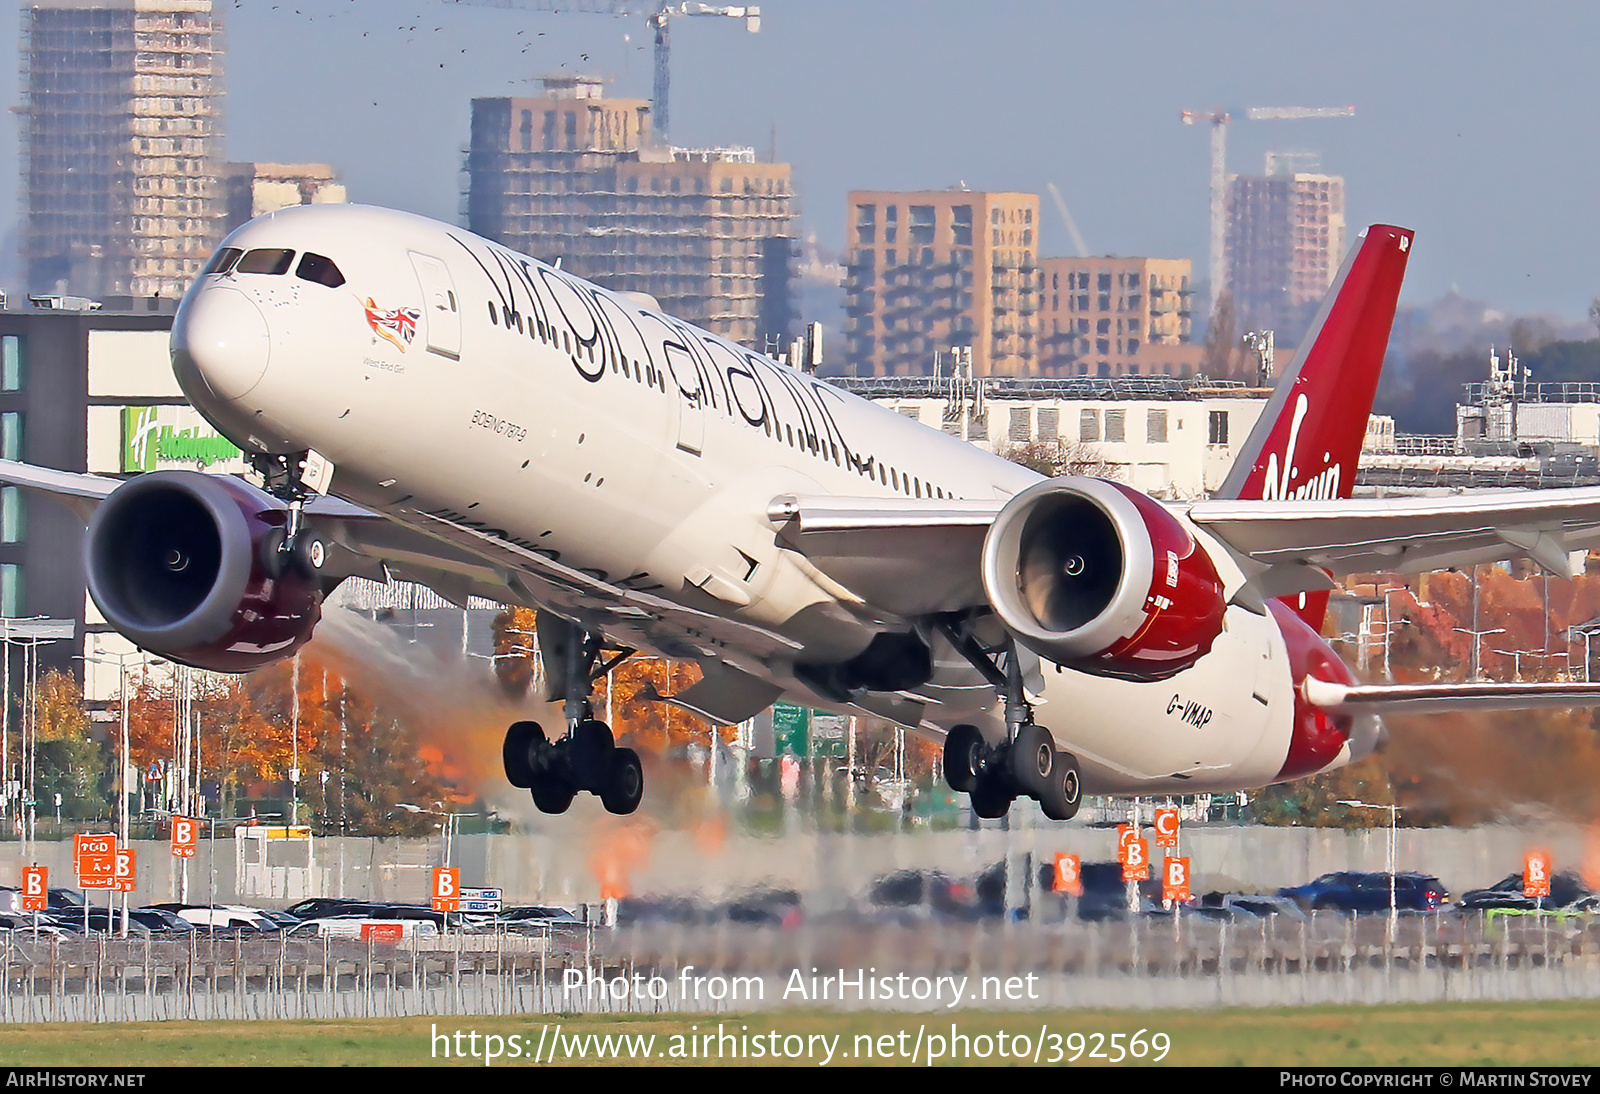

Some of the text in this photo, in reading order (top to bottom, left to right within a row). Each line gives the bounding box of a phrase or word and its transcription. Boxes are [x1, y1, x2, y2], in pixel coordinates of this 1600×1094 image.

[362, 356, 380, 368] West
[380, 361, 394, 372] End
[471, 409, 528, 442] BOEING 787-9
[1166, 693, 1213, 730] G-VMAP
[177, 822, 191, 843] B
[1157, 812, 1174, 835] C
[1127, 843, 1142, 865] B
[116, 855, 130, 877] B
[1169, 862, 1185, 885] B
[27, 873, 42, 895] B
[438, 873, 454, 897] B
